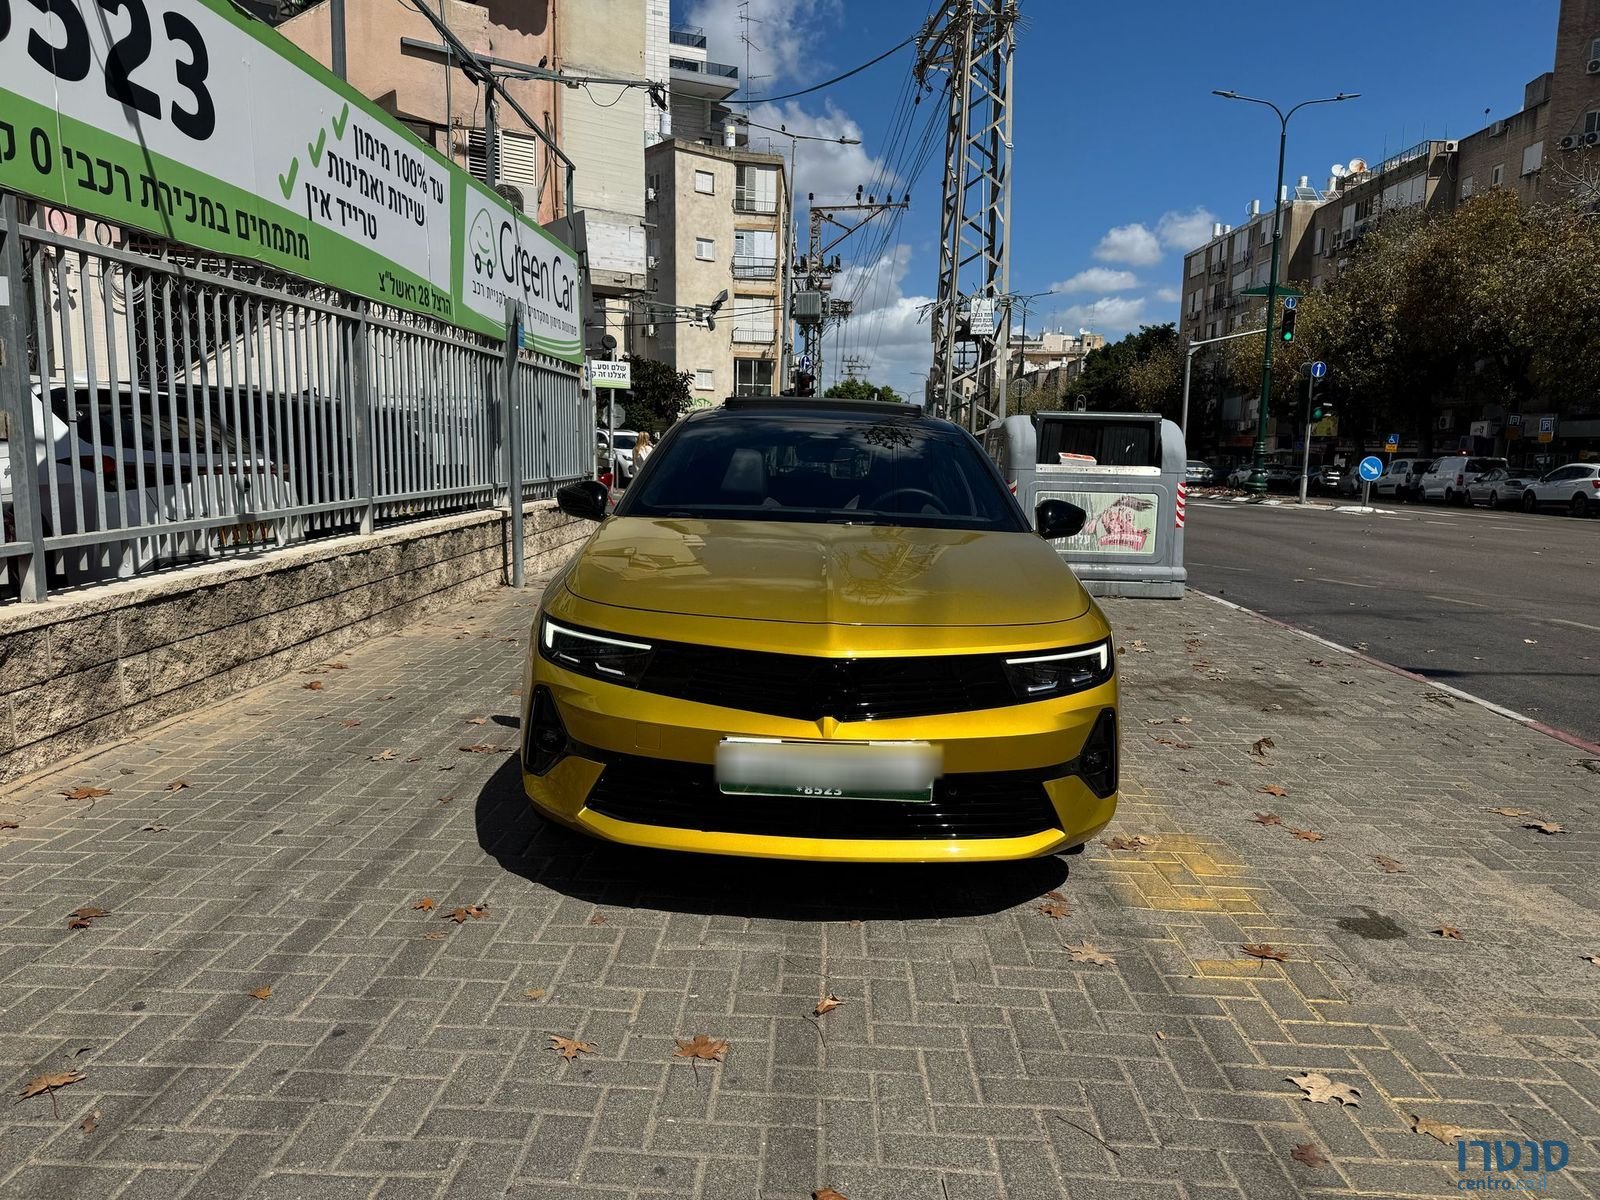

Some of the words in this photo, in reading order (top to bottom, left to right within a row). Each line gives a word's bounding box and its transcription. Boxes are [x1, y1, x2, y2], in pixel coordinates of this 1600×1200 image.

[0, 0, 215, 140] 523
[30, 127, 52, 175] 0
[353, 124, 390, 171] מימון
[62, 145, 132, 202] רכבי
[327, 150, 385, 206] ואמינות
[394, 149, 427, 194] 100%
[430, 176, 444, 204] עד
[139, 174, 231, 235] במכירת
[305, 182, 332, 221] אין
[336, 197, 377, 240] טרייד
[388, 185, 425, 226] שירות
[235, 209, 310, 261] מתמחים
[472, 280, 485, 297] רכב
[500, 221, 550, 302] Green
[552, 256, 574, 313] Car
[418, 285, 430, 307] 28
[431, 289, 451, 315] הרצל
[598, 370, 606, 378] זה
[607, 370, 627, 379] אצלנו
